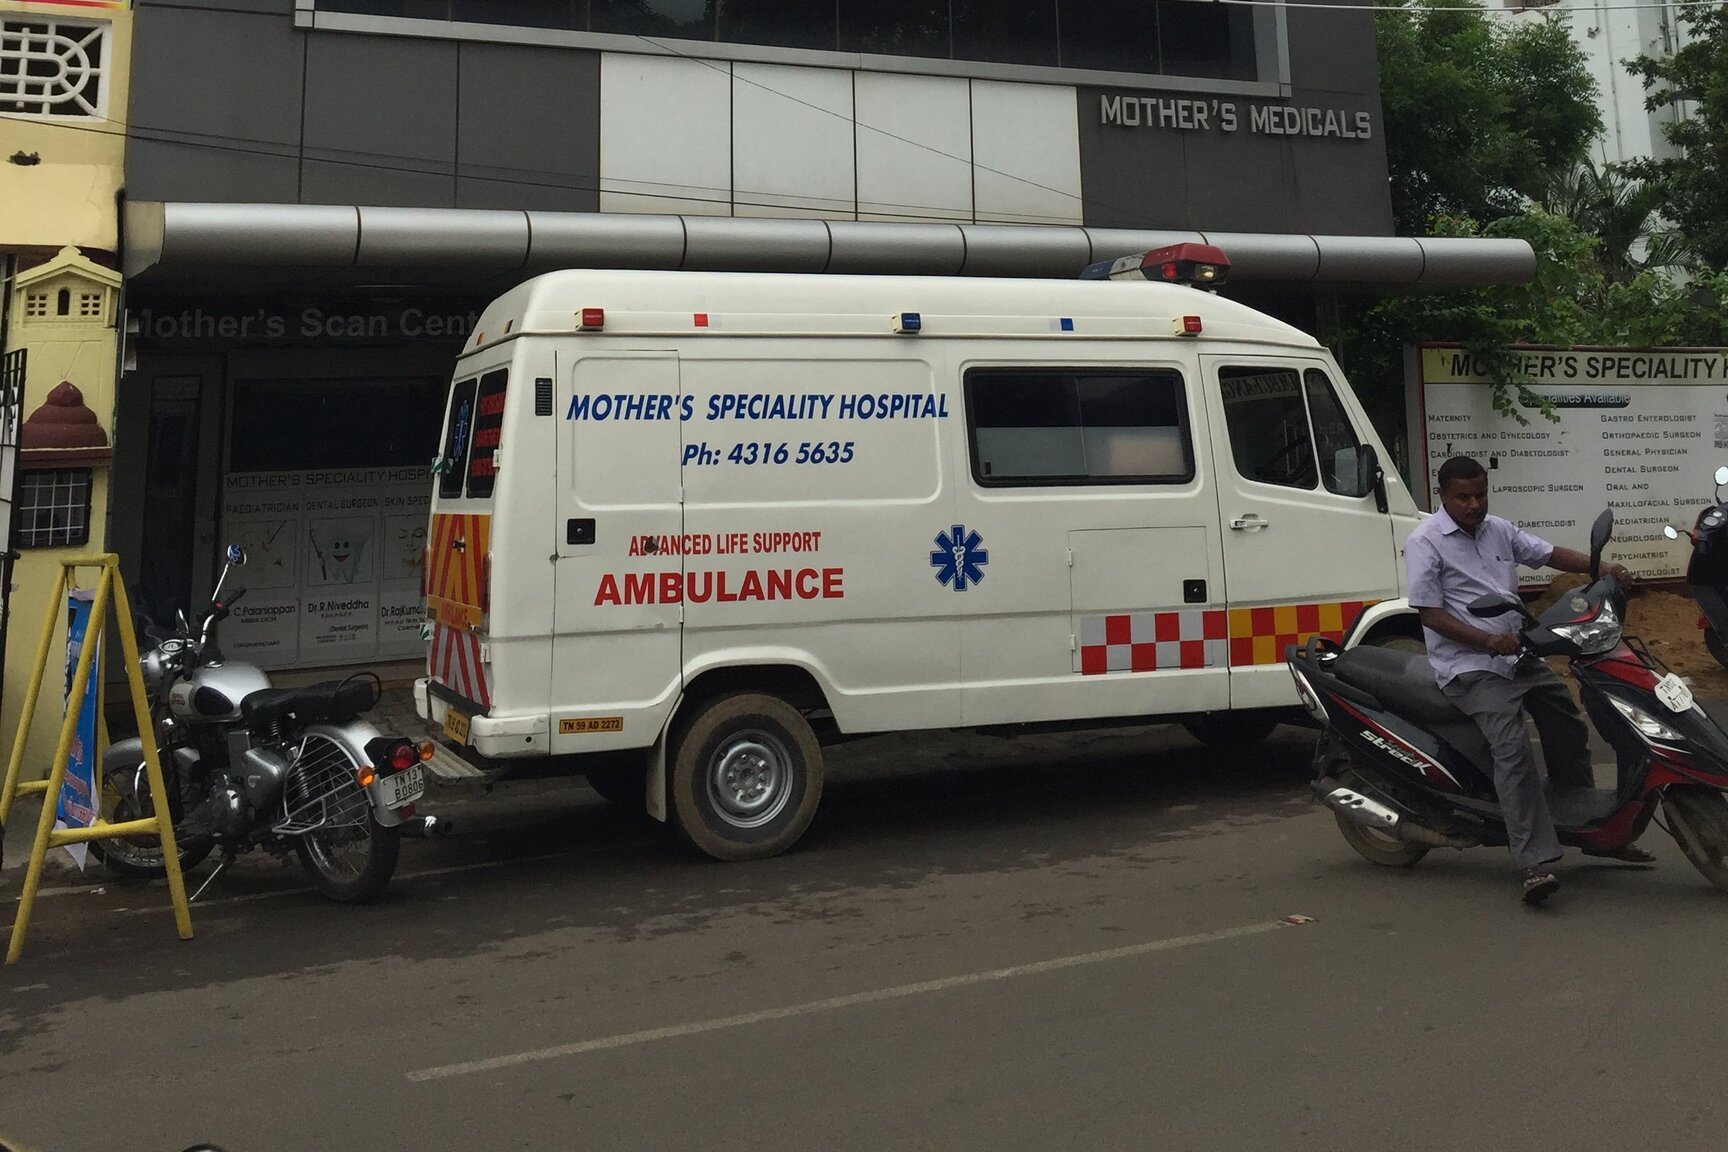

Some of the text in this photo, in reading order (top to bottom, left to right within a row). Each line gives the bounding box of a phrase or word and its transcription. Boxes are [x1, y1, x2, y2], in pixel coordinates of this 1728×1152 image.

[1100, 93, 1372, 140] MOTHER'S MEDICALS
[299, 307, 387, 337] Scan
[1586, 354, 1717, 380] SPECIALITY
[566, 392, 949, 422] MOTHER'S SPECIALITY HOSPITAL
[1428, 413, 1471, 423] MATERNITY
[1600, 413, 1697, 423] GASTRO ENTEROLOGIST
[1429, 430, 1551, 440] OBSTETRICS AND GYNECOLOGY
[1602, 430, 1702, 440] ORTHOPAEDIC SURGEON
[682, 441, 855, 467] Ph: 4316 5635
[1491, 449, 1507, 458] AND
[1510, 448, 1569, 458] DIABETOLOGIST
[1603, 447, 1688, 457] GENERAL PHYSICIAN
[1604, 465, 1680, 474] DENTAL SURGEON
[226, 473, 300, 489] MOTHER'S
[305, 469, 385, 486] SPECIALITY
[1492, 482, 1584, 494] LAPROSCOPIC SURGEON
[1606, 483, 1649, 492] ORAL AND
[225, 502, 299, 515] PAEDIATRICIAN
[305, 499, 339, 510] DENTAL
[340, 497, 379, 509] SURGEON
[384, 496, 405, 507] SKIN
[1607, 497, 1712, 509] MAXILLOFACIAL SURGEON
[1517, 519, 1576, 528] DIABETOLOGIST
[1613, 517, 1670, 526] AEDIATRICIAN
[716, 533, 749, 555] LIFE
[753, 531, 822, 554] SUPPORT
[1611, 551, 1669, 561] PSYCHIATRIST
[593, 567, 845, 607] AMBULANCE
[563, 721, 575, 731] TN
[576, 721, 586, 730] 59
[601, 719, 620, 729] 2272
